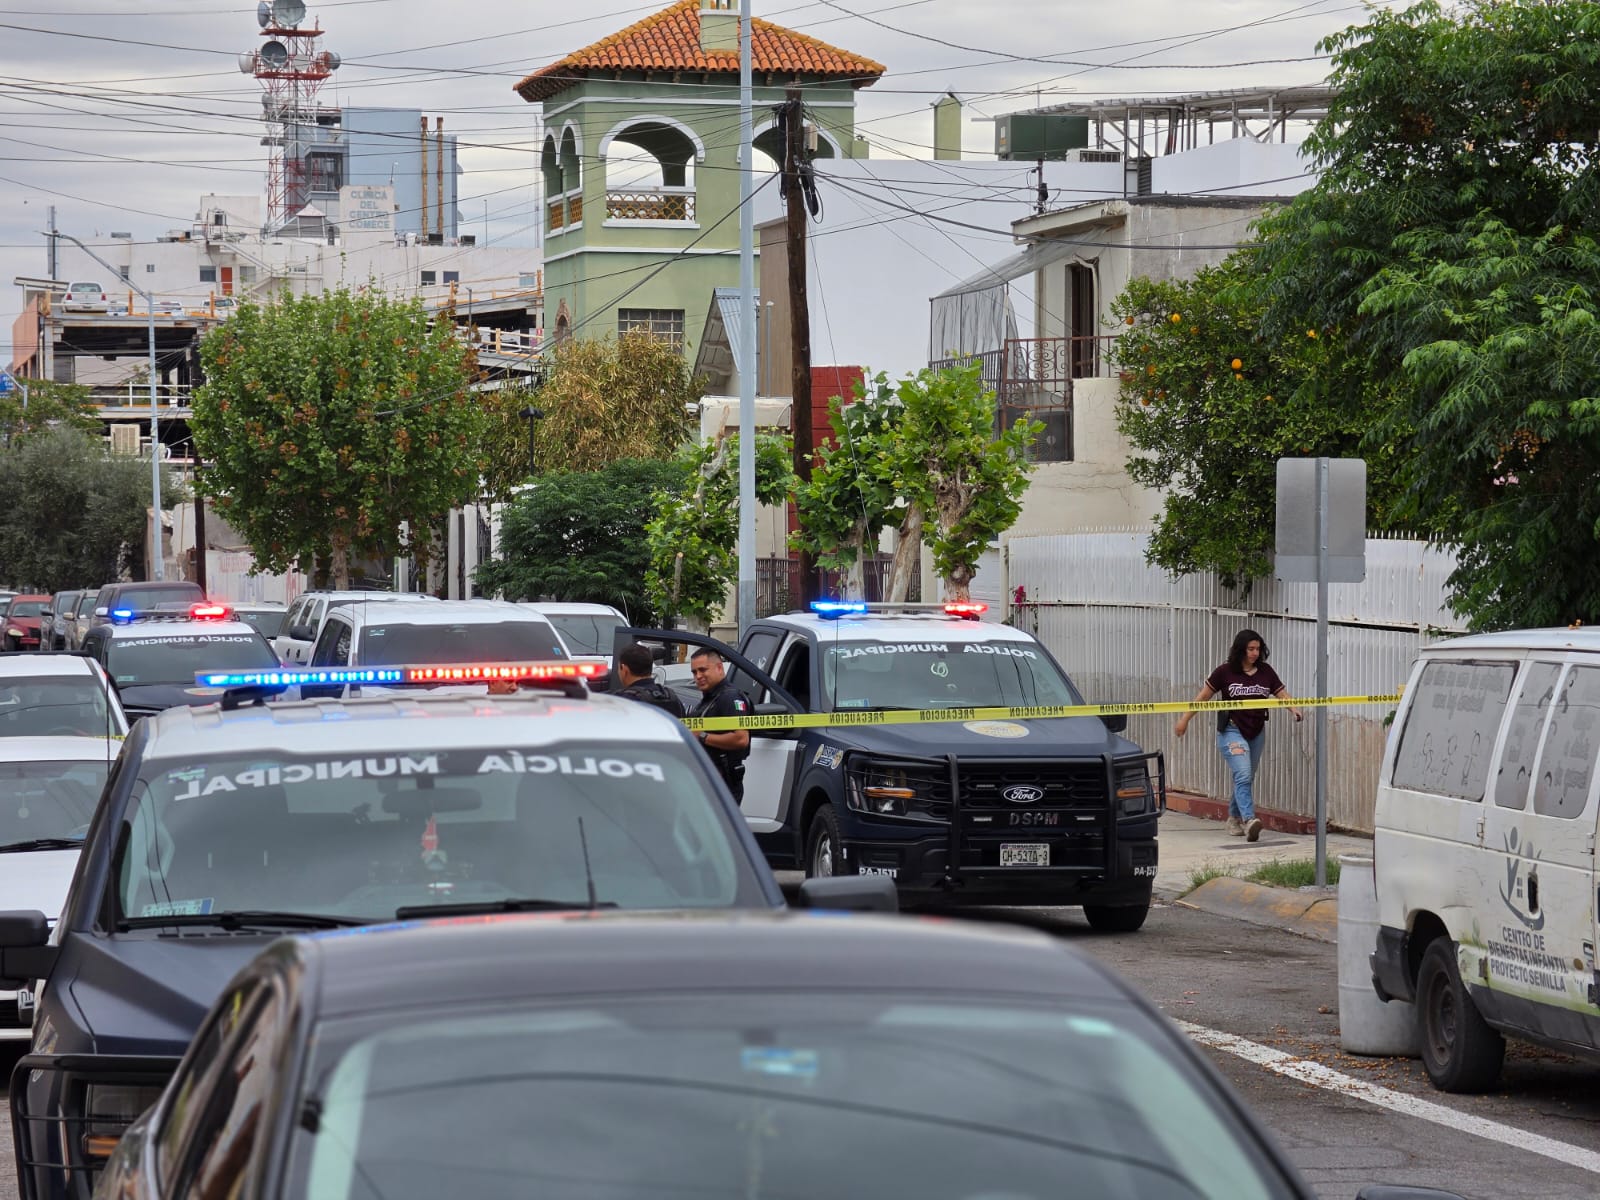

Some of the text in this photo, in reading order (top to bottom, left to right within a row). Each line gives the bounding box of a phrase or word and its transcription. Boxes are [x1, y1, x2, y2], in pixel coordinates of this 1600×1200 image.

[360, 200, 379, 210] DEL
[1008, 812, 1060, 826] DSPM
[1533, 934, 1546, 951] DE
[1490, 958, 1567, 992] PROYECTO SEMILLA
